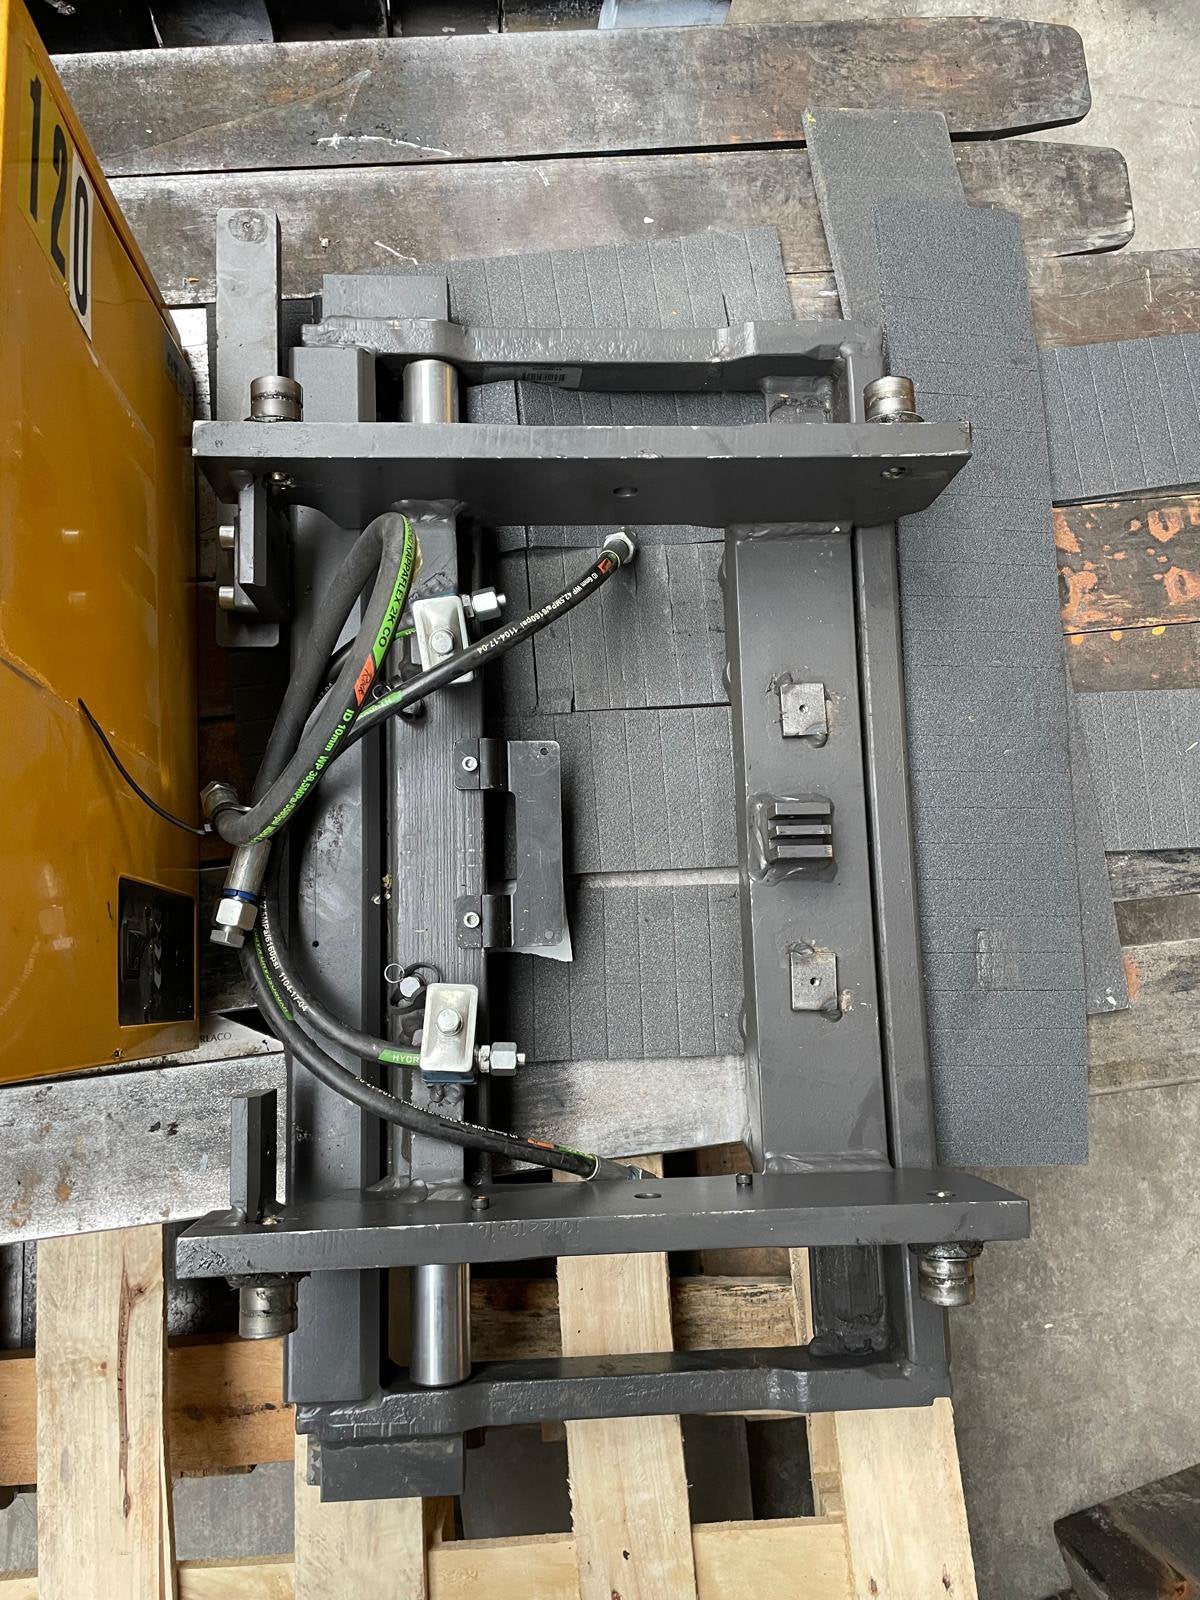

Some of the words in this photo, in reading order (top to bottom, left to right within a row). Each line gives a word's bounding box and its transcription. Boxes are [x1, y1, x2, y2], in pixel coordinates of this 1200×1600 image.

[30, 74, 89, 316] 120
[386, 607, 401, 626] 2K
[378, 626, 392, 649] CO
[476, 627, 518, 654] 1104-17-04
[342, 708, 355, 722] ID
[325, 724, 347, 752] 10mm
[314, 755, 329, 771] WP
[279, 972, 309, 1012] 1104-17-04
